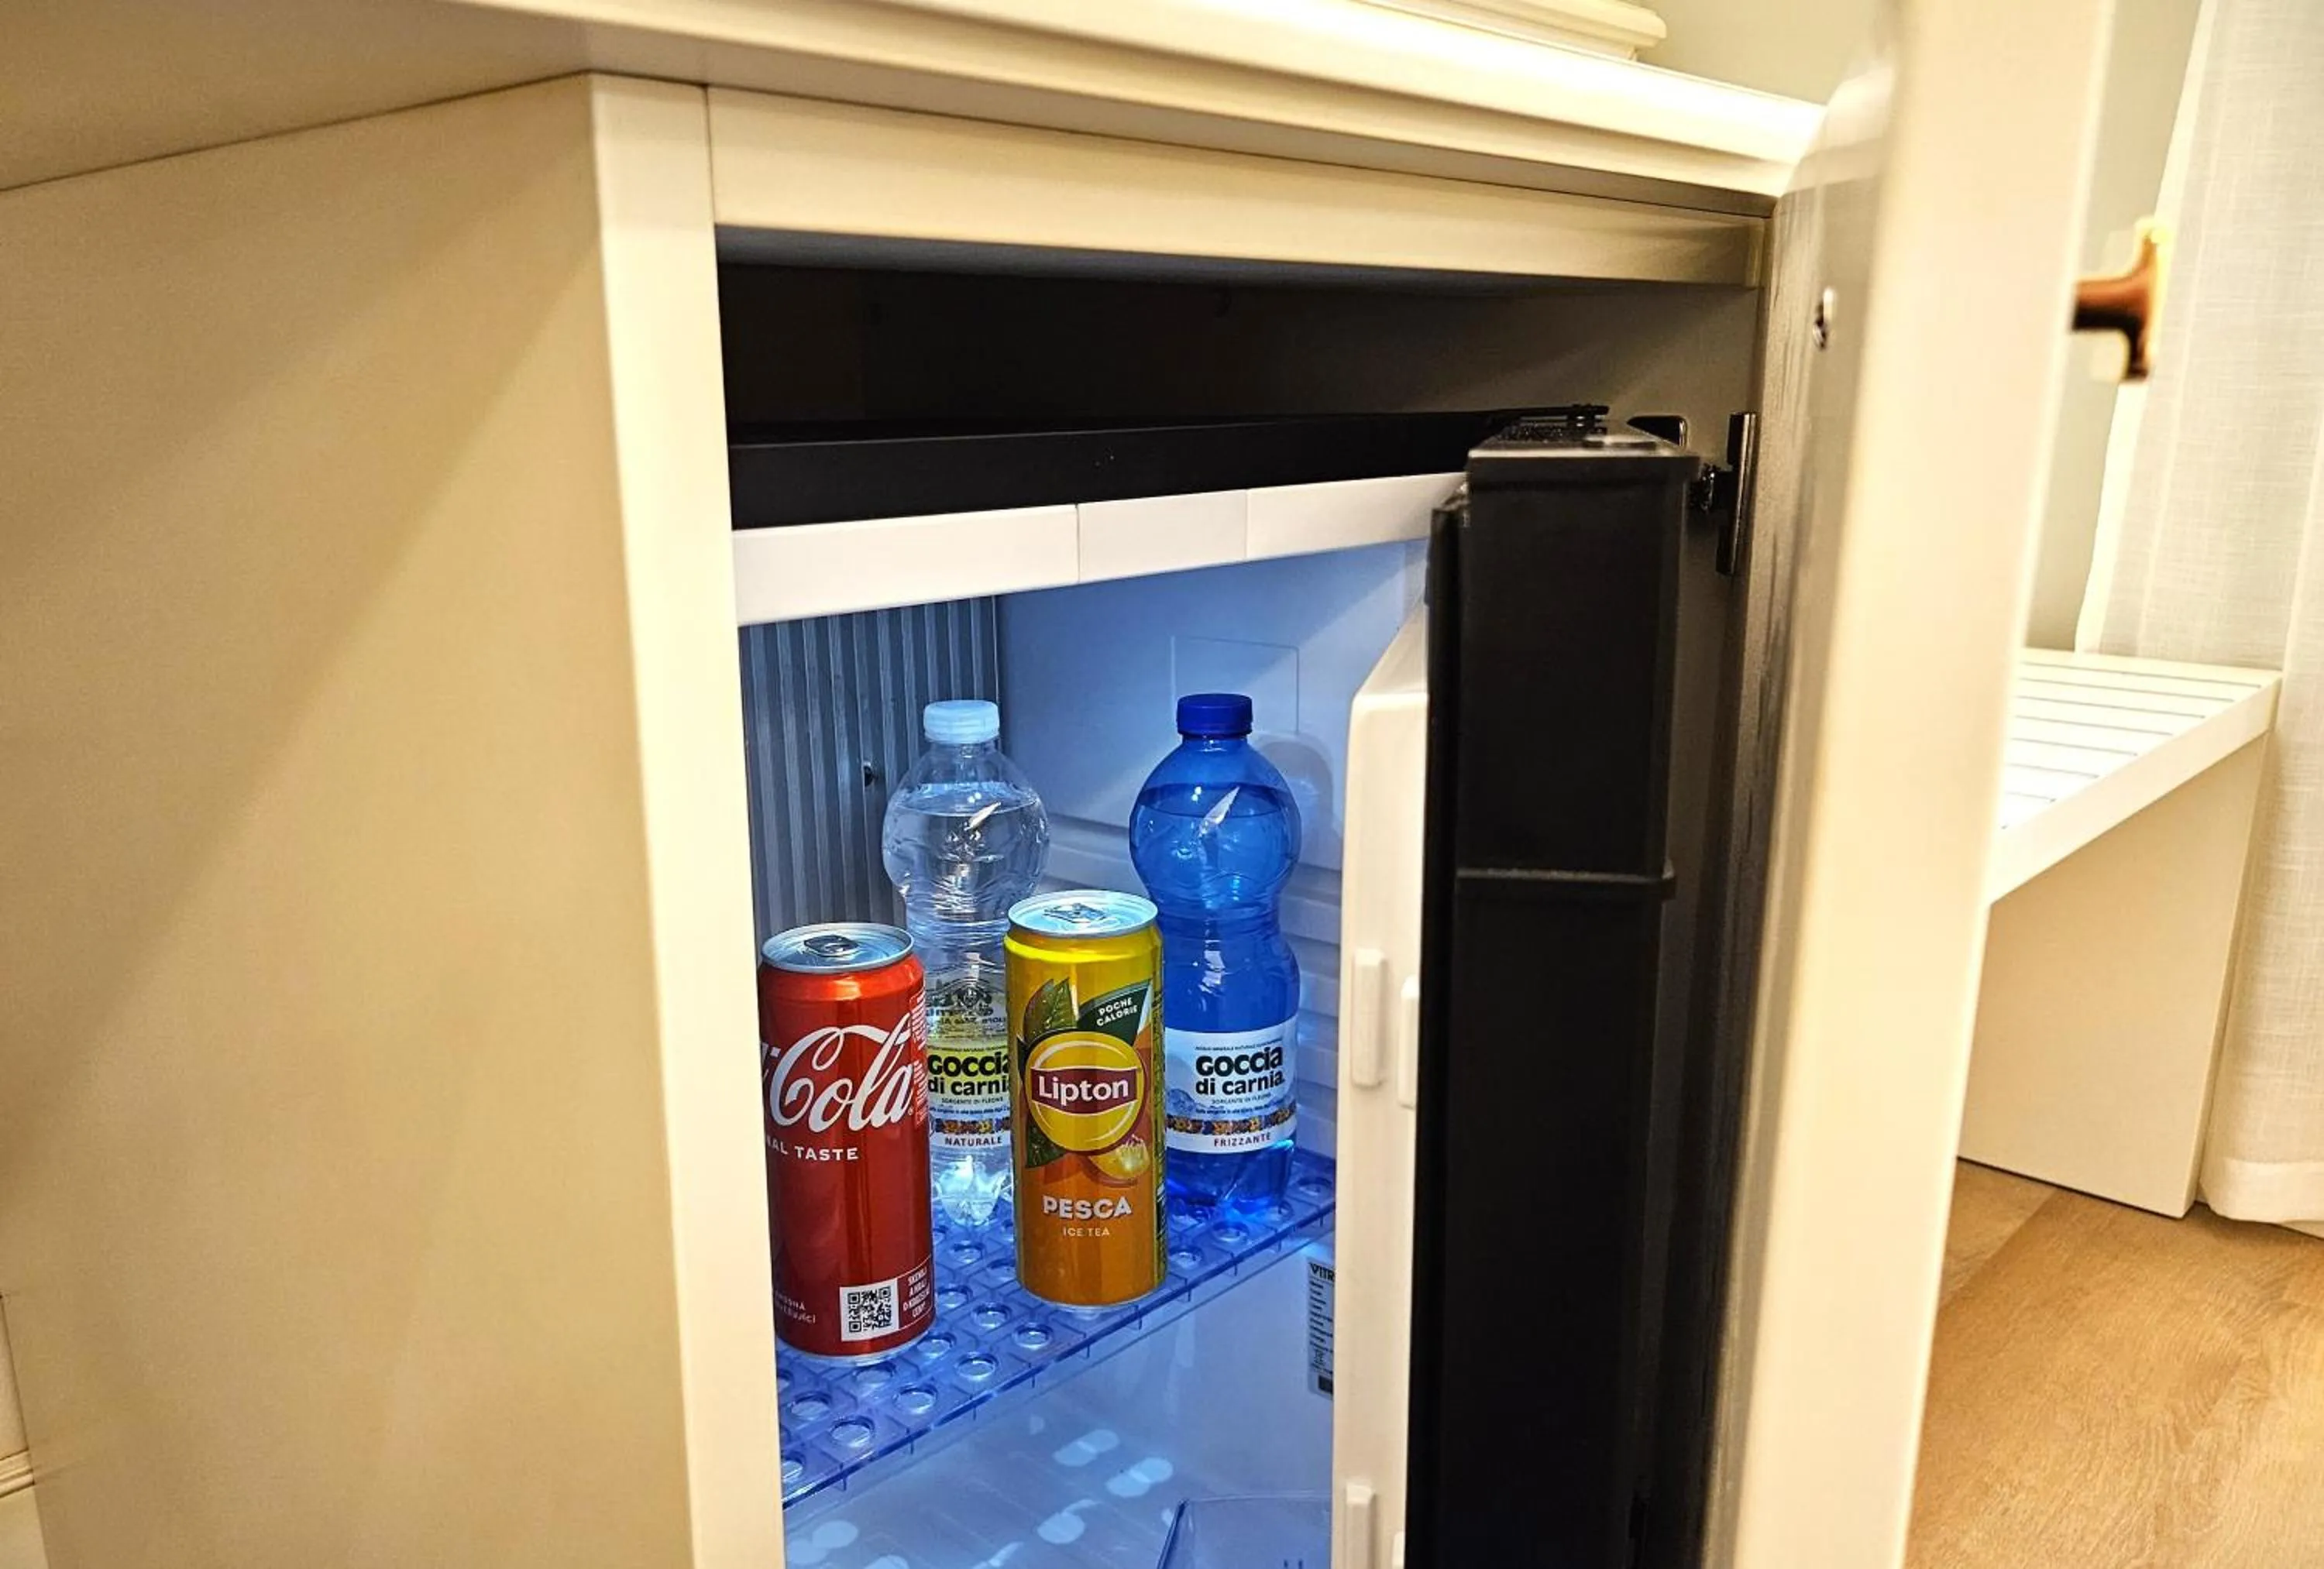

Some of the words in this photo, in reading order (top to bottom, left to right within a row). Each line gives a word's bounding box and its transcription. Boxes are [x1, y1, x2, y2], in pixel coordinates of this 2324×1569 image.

[1096, 1005, 1138, 1026] CALORIE
[1098, 997, 1133, 1015] POCHE
[928, 1077, 945, 1093] di
[951, 1076, 1010, 1096] carni
[1038, 1076, 1129, 1106] Lipton
[1195, 1077, 1215, 1095] di
[1222, 1070, 1284, 1095] carnia
[944, 1136, 1002, 1146] NATURALE
[1214, 1131, 1271, 1147] FRIZZANTE
[794, 1145, 859, 1161] TASTE
[1043, 1195, 1132, 1220] PESCA
[1063, 1226, 1084, 1237] ICE
[1088, 1227, 1110, 1237] TEA
